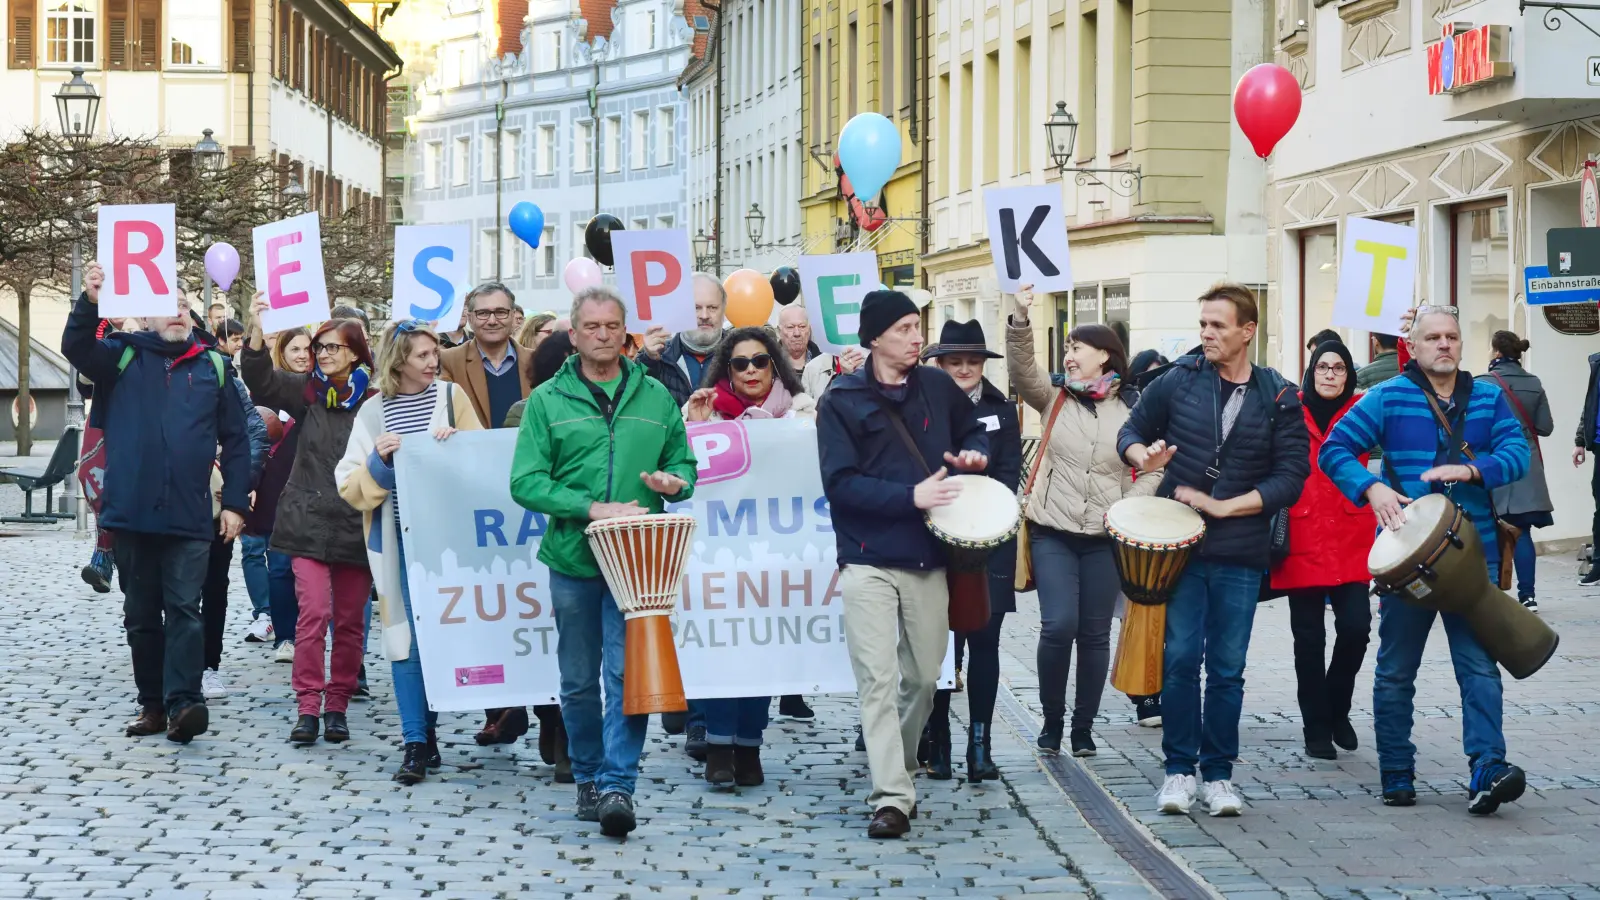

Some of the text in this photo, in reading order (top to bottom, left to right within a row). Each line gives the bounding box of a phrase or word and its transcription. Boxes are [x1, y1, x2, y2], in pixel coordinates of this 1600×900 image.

[113, 220, 170, 296] R
[266, 231, 309, 309] E
[999, 205, 1060, 280] K
[1354, 239, 1407, 317] T
[409, 246, 455, 321] S
[630, 250, 682, 320] P
[817, 274, 861, 345] E
[1531, 277, 1600, 290] Einbahnstraße
